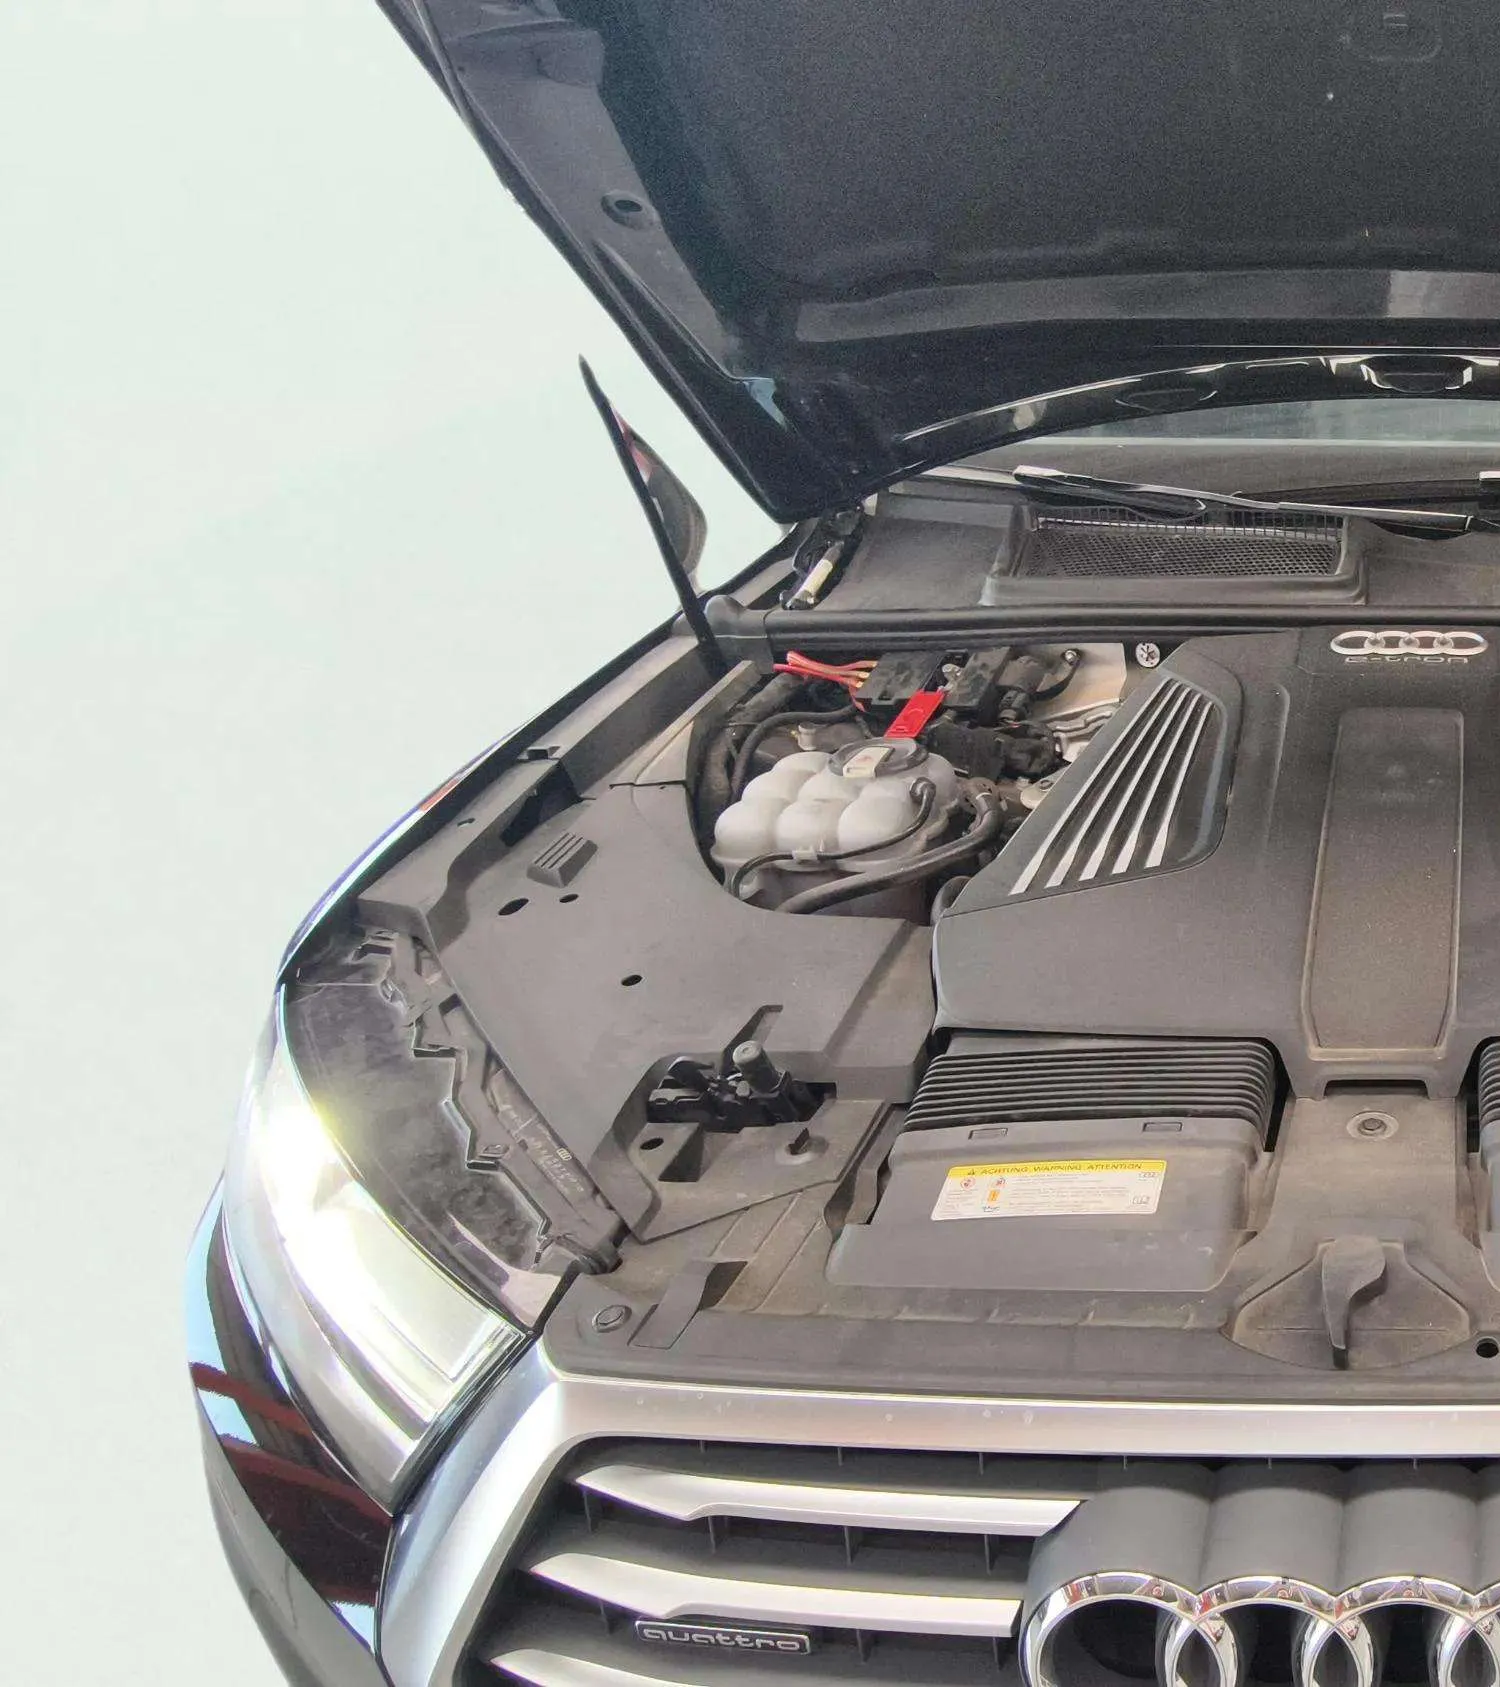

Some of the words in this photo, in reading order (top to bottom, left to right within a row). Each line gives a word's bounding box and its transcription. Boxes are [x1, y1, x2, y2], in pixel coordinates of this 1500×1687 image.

[1344, 655, 1469, 664] e-tron
[980, 1166, 1028, 1175] ACHTUNG
[1033, 1164, 1082, 1172] WARNING
[1087, 1162, 1142, 1171] ATTENTION
[642, 1628, 800, 1650] quattro
